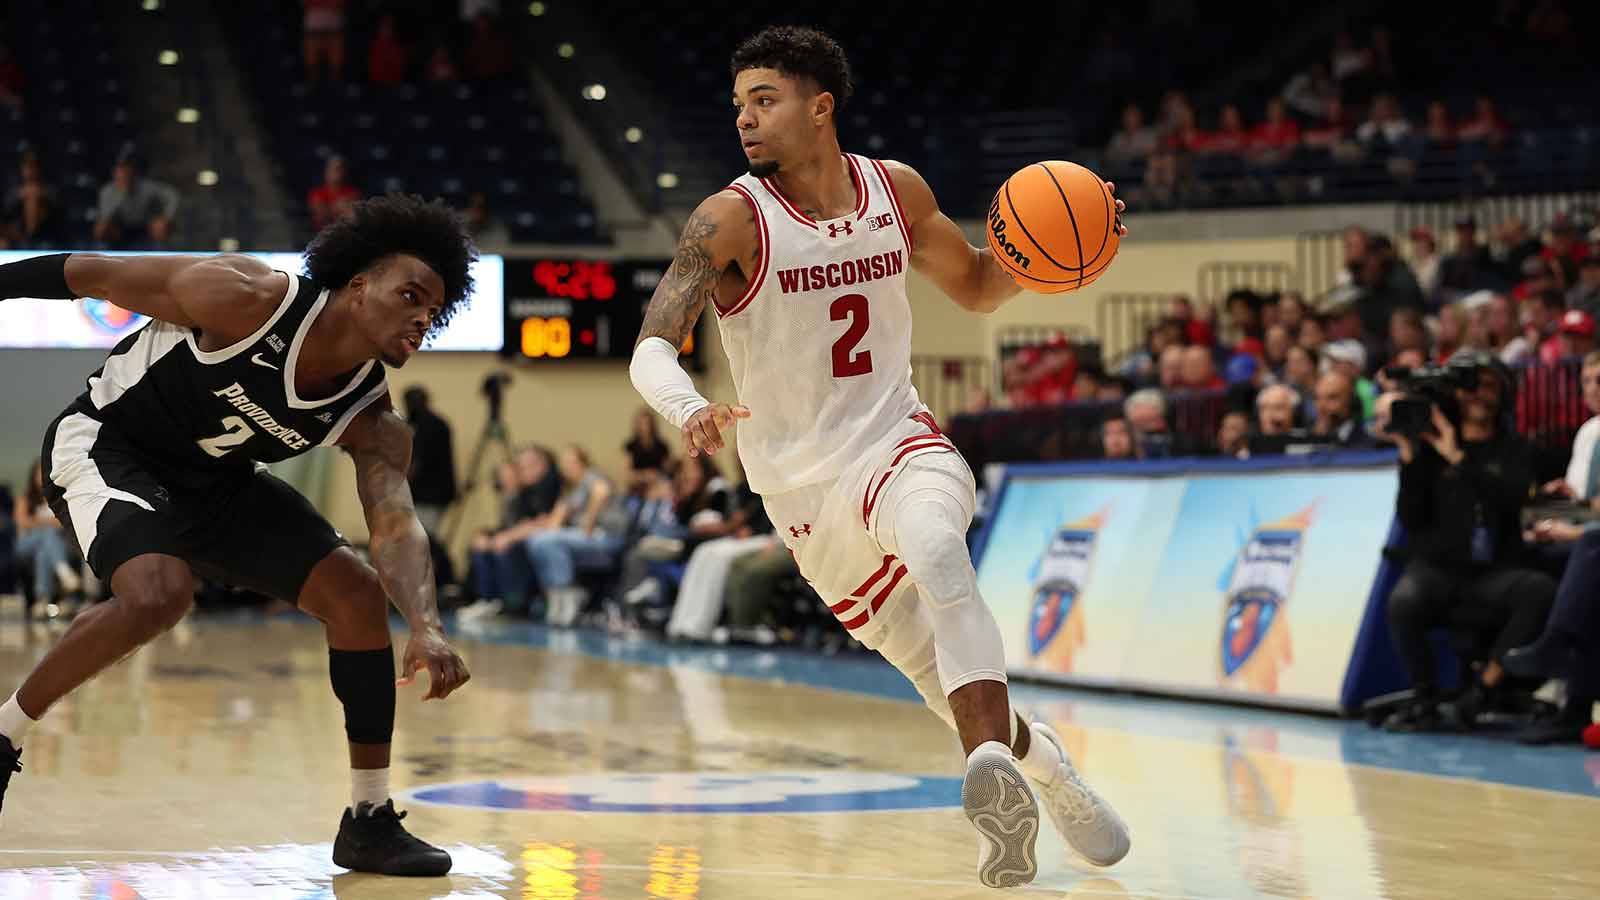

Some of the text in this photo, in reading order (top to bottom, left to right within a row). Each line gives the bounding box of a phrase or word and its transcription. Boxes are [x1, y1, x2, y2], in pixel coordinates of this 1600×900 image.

[776, 250, 904, 294] WISCONSIN
[829, 293, 873, 378] 2
[197, 416, 256, 458] 2
[212, 381, 311, 450] PROVIDENCE
